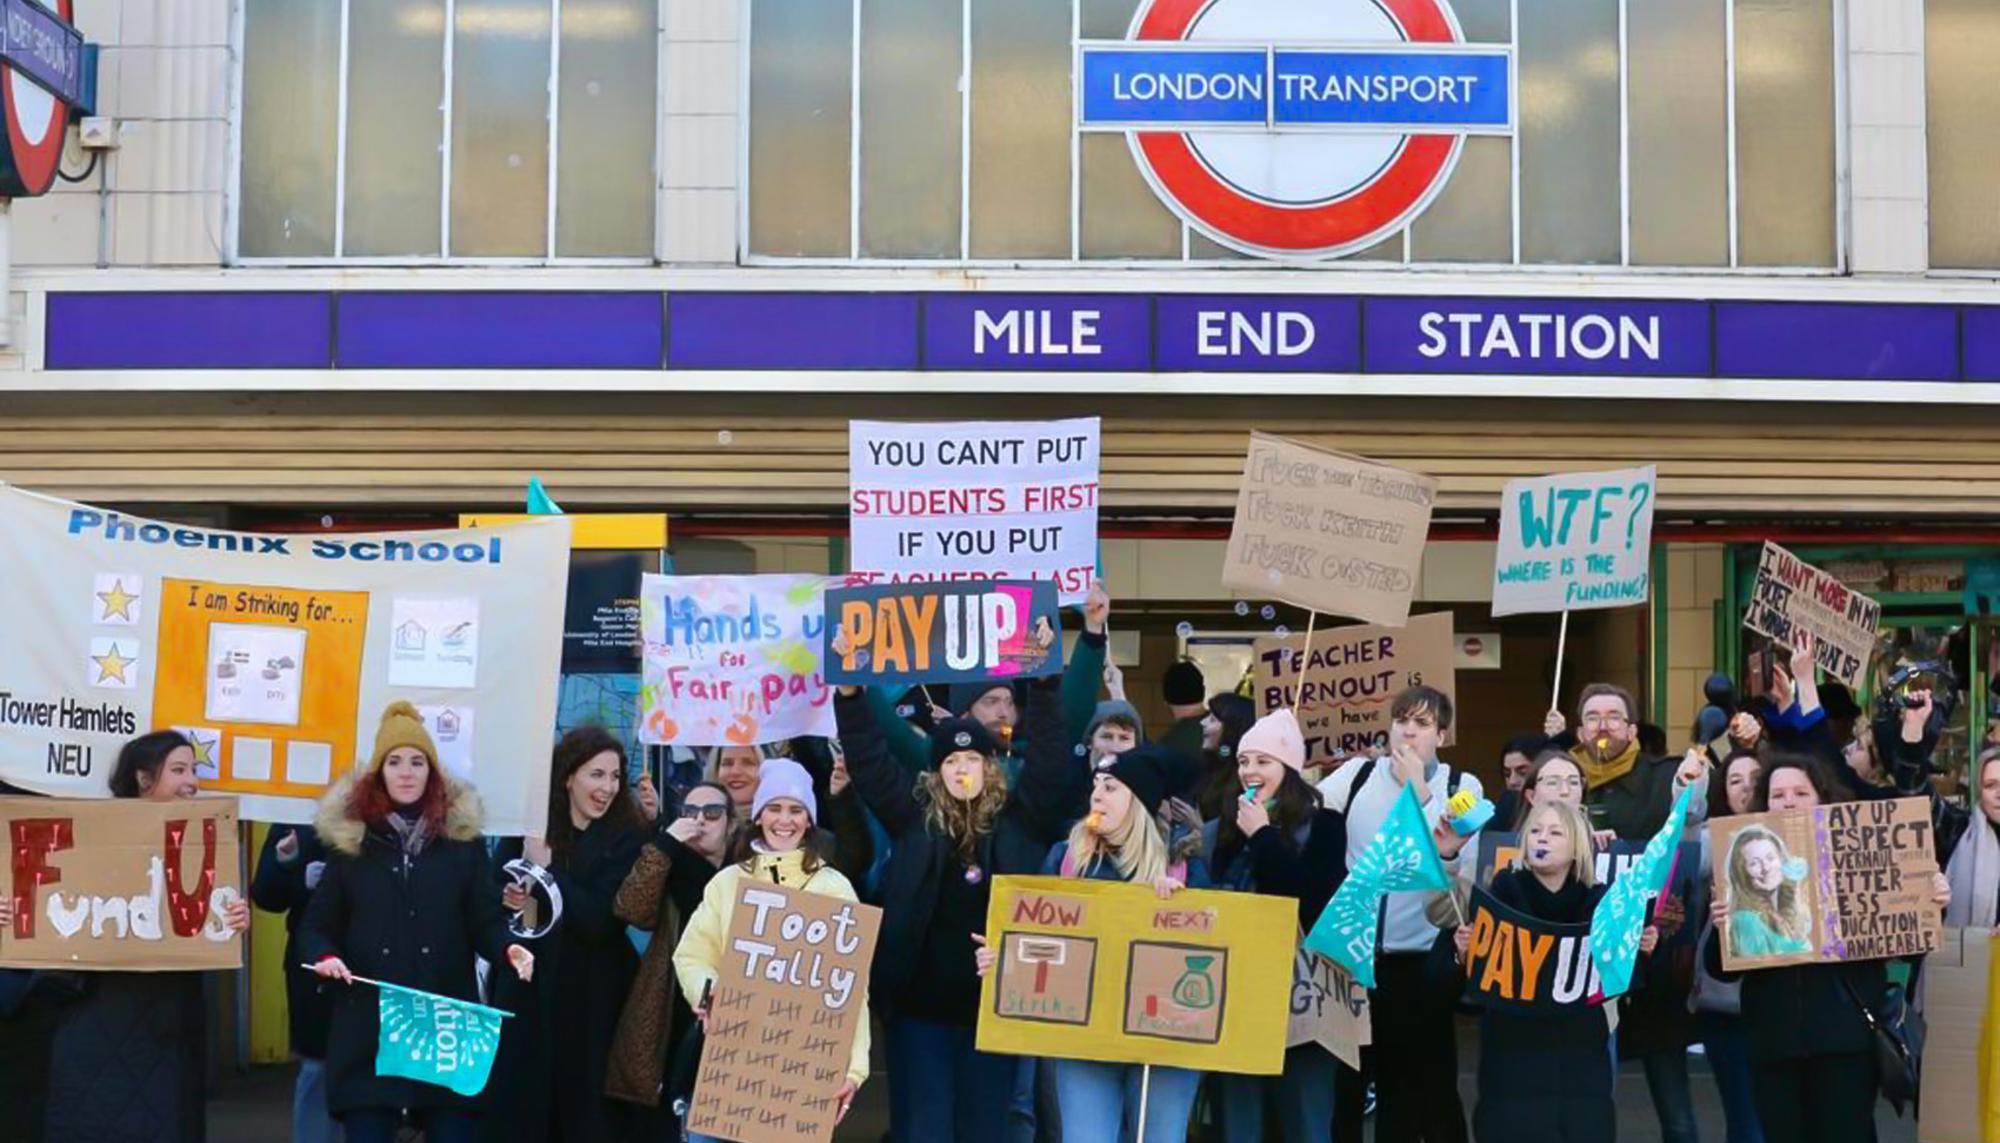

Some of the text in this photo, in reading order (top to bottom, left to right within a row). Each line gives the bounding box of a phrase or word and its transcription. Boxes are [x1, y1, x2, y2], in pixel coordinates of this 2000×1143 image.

[1113, 73, 1478, 103] LONDON TRANSPORT
[973, 309, 1661, 360] MILE END STATION
[868, 436, 1088, 466] YOU CAN'T PUT
[852, 483, 1098, 515] STUDENTS FIRST
[1519, 482, 1650, 550] WTF?
[68, 508, 501, 564] Phoenix School
[898, 526, 1062, 556] IF YOU PUT
[1498, 553, 1616, 584] WHERE IS THE
[1565, 572, 1648, 603] FUNDING?
[1760, 547, 1776, 576] I
[1777, 553, 1815, 592] WANT
[1813, 576, 1849, 614] MORE
[1847, 595, 1863, 625] IN
[188, 585, 200, 607] I
[205, 592, 227, 611] am
[234, 591, 300, 623] Striking
[664, 594, 782, 647] Hands
[841, 592, 1017, 674] PAY UP
[1261, 636, 1396, 678] TEACHER
[667, 665, 829, 715] Fair pay
[1264, 670, 1397, 710] BURNOUT
[0, 692, 137, 734] Tower Hamlets
[1306, 708, 1380, 730] we have
[46, 742, 92, 777] NEU
[1304, 730, 1391, 760] TURNO
[1871, 801, 1898, 826] UP
[9, 817, 244, 942] Fund Us
[743, 888, 861, 955] Toot
[1012, 895, 1214, 929] NOW NEXT
[733, 938, 855, 1009] Tally
[1467, 905, 1555, 1001] PAY
